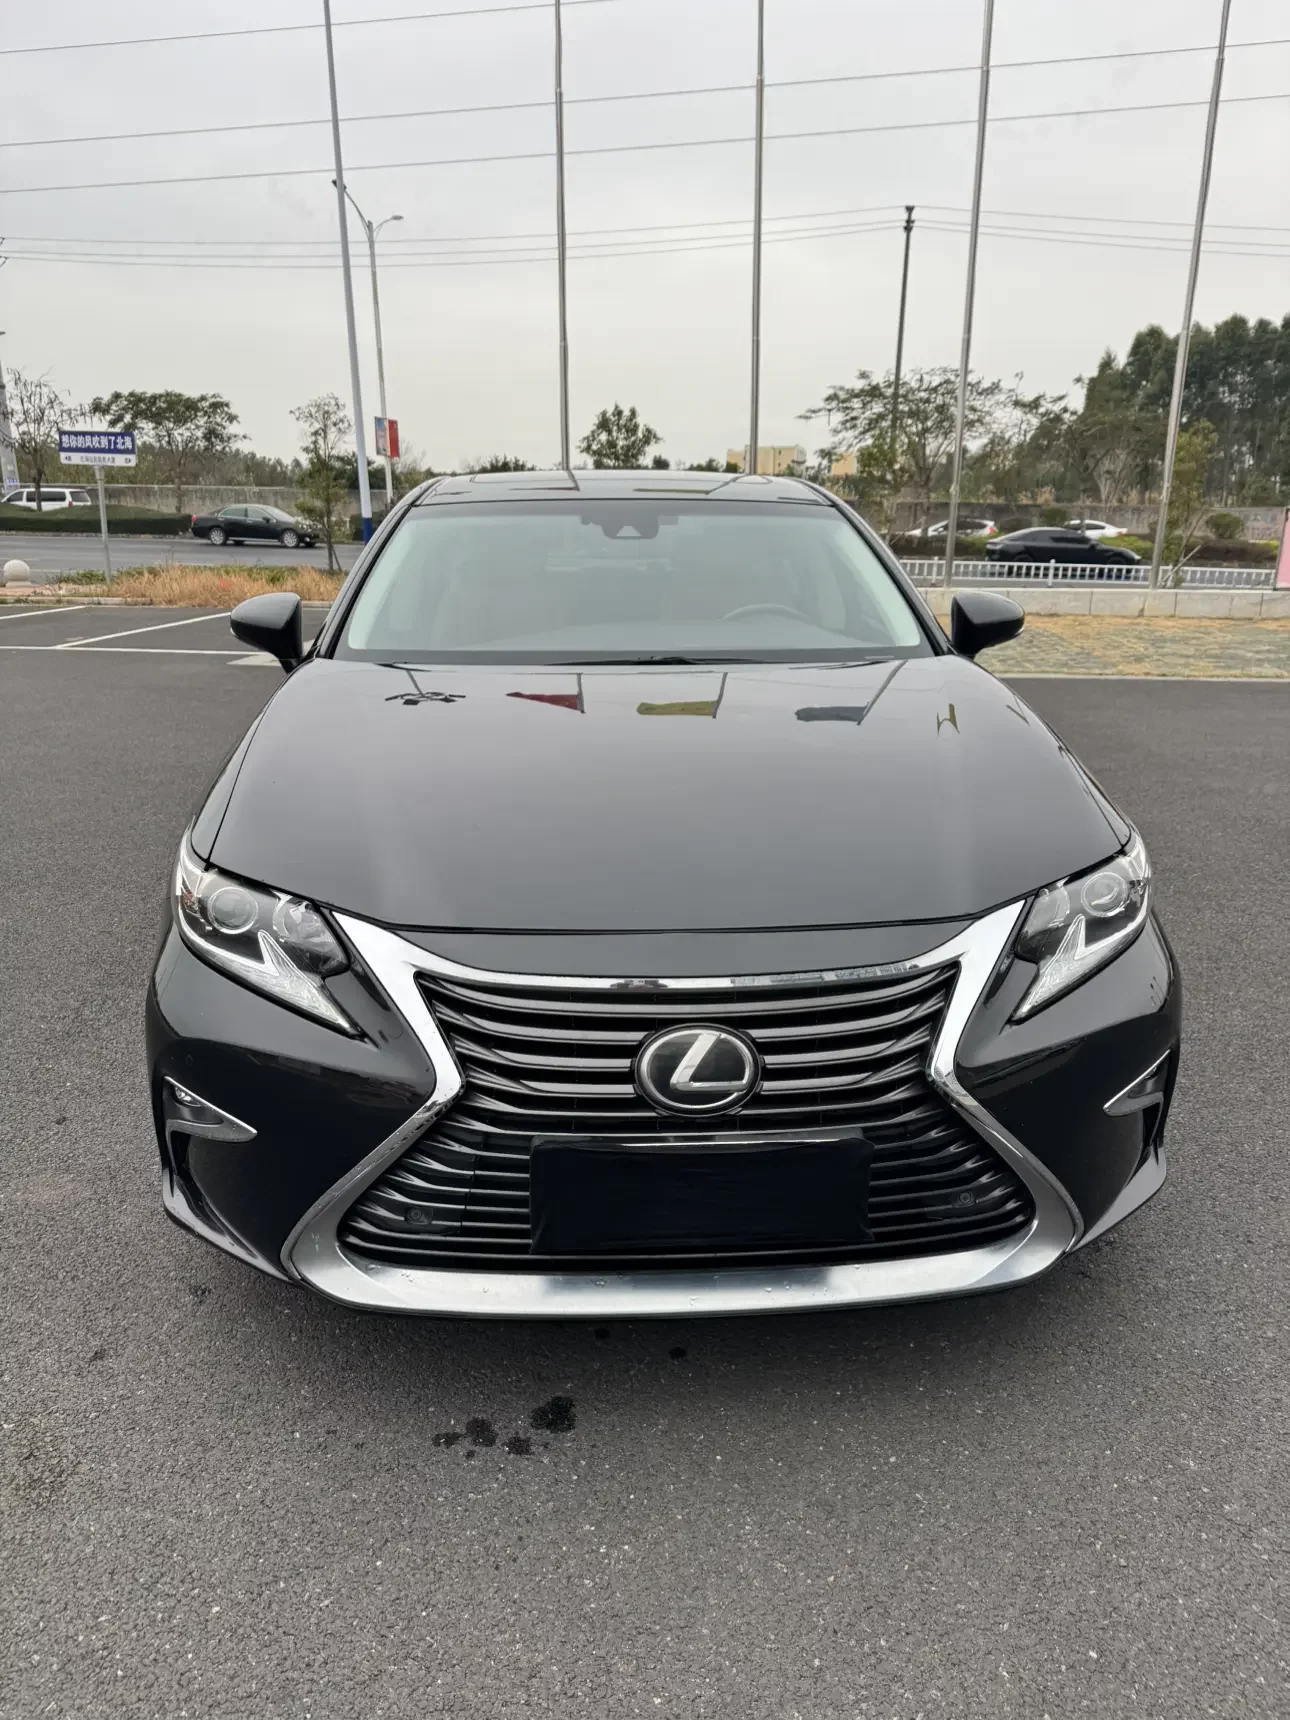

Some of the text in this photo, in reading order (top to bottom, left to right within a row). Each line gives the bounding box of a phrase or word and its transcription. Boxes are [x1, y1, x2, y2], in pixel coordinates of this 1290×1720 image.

[61, 434, 132, 450] 想你的风吹到了北海
